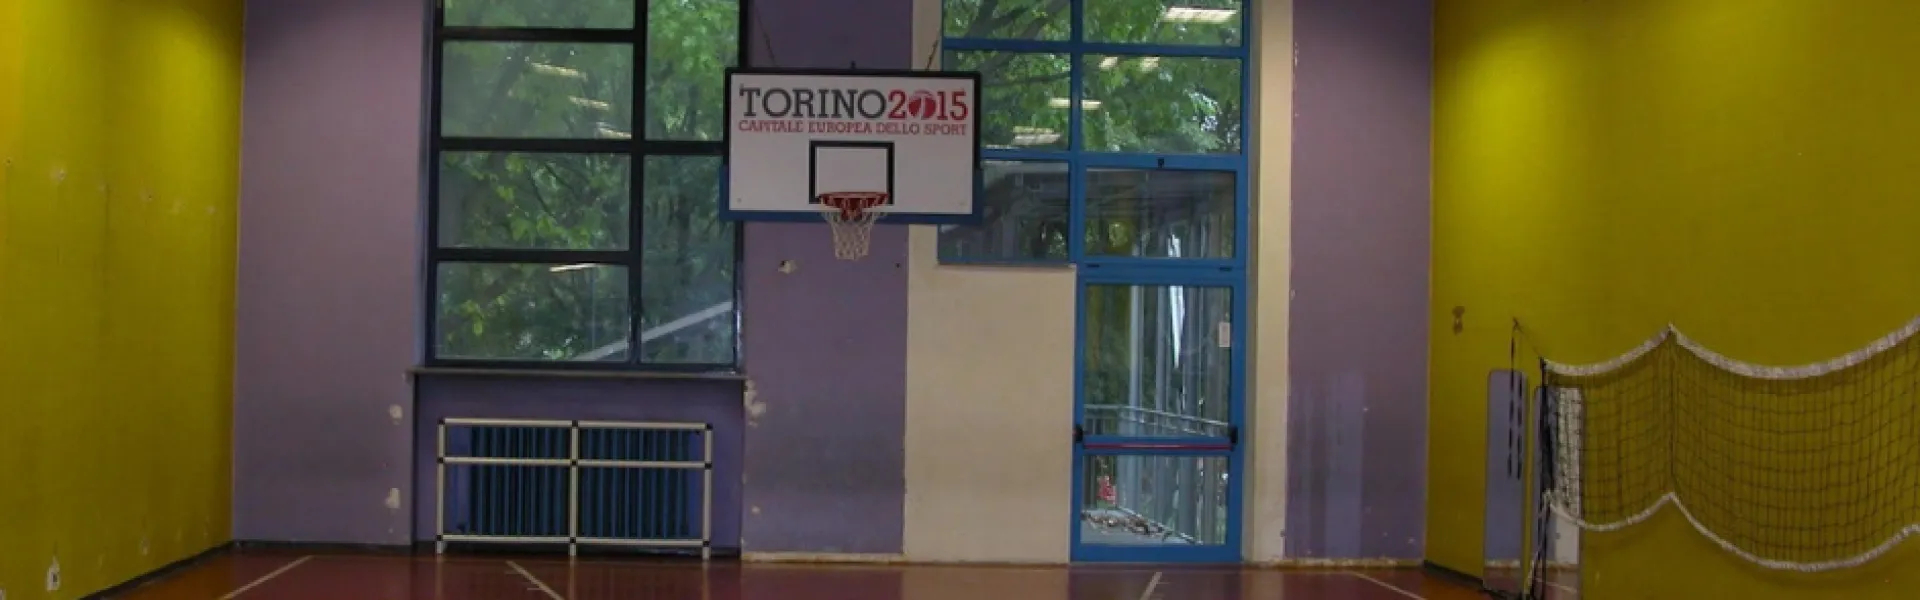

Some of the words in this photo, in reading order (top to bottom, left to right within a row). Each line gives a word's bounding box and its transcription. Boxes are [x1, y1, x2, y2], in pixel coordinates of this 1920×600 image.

[738, 119, 804, 133] CAPITALE
[808, 121, 873, 135] EUROPEA
[875, 122, 920, 135] DELLO
[923, 122, 967, 136] SPORT
